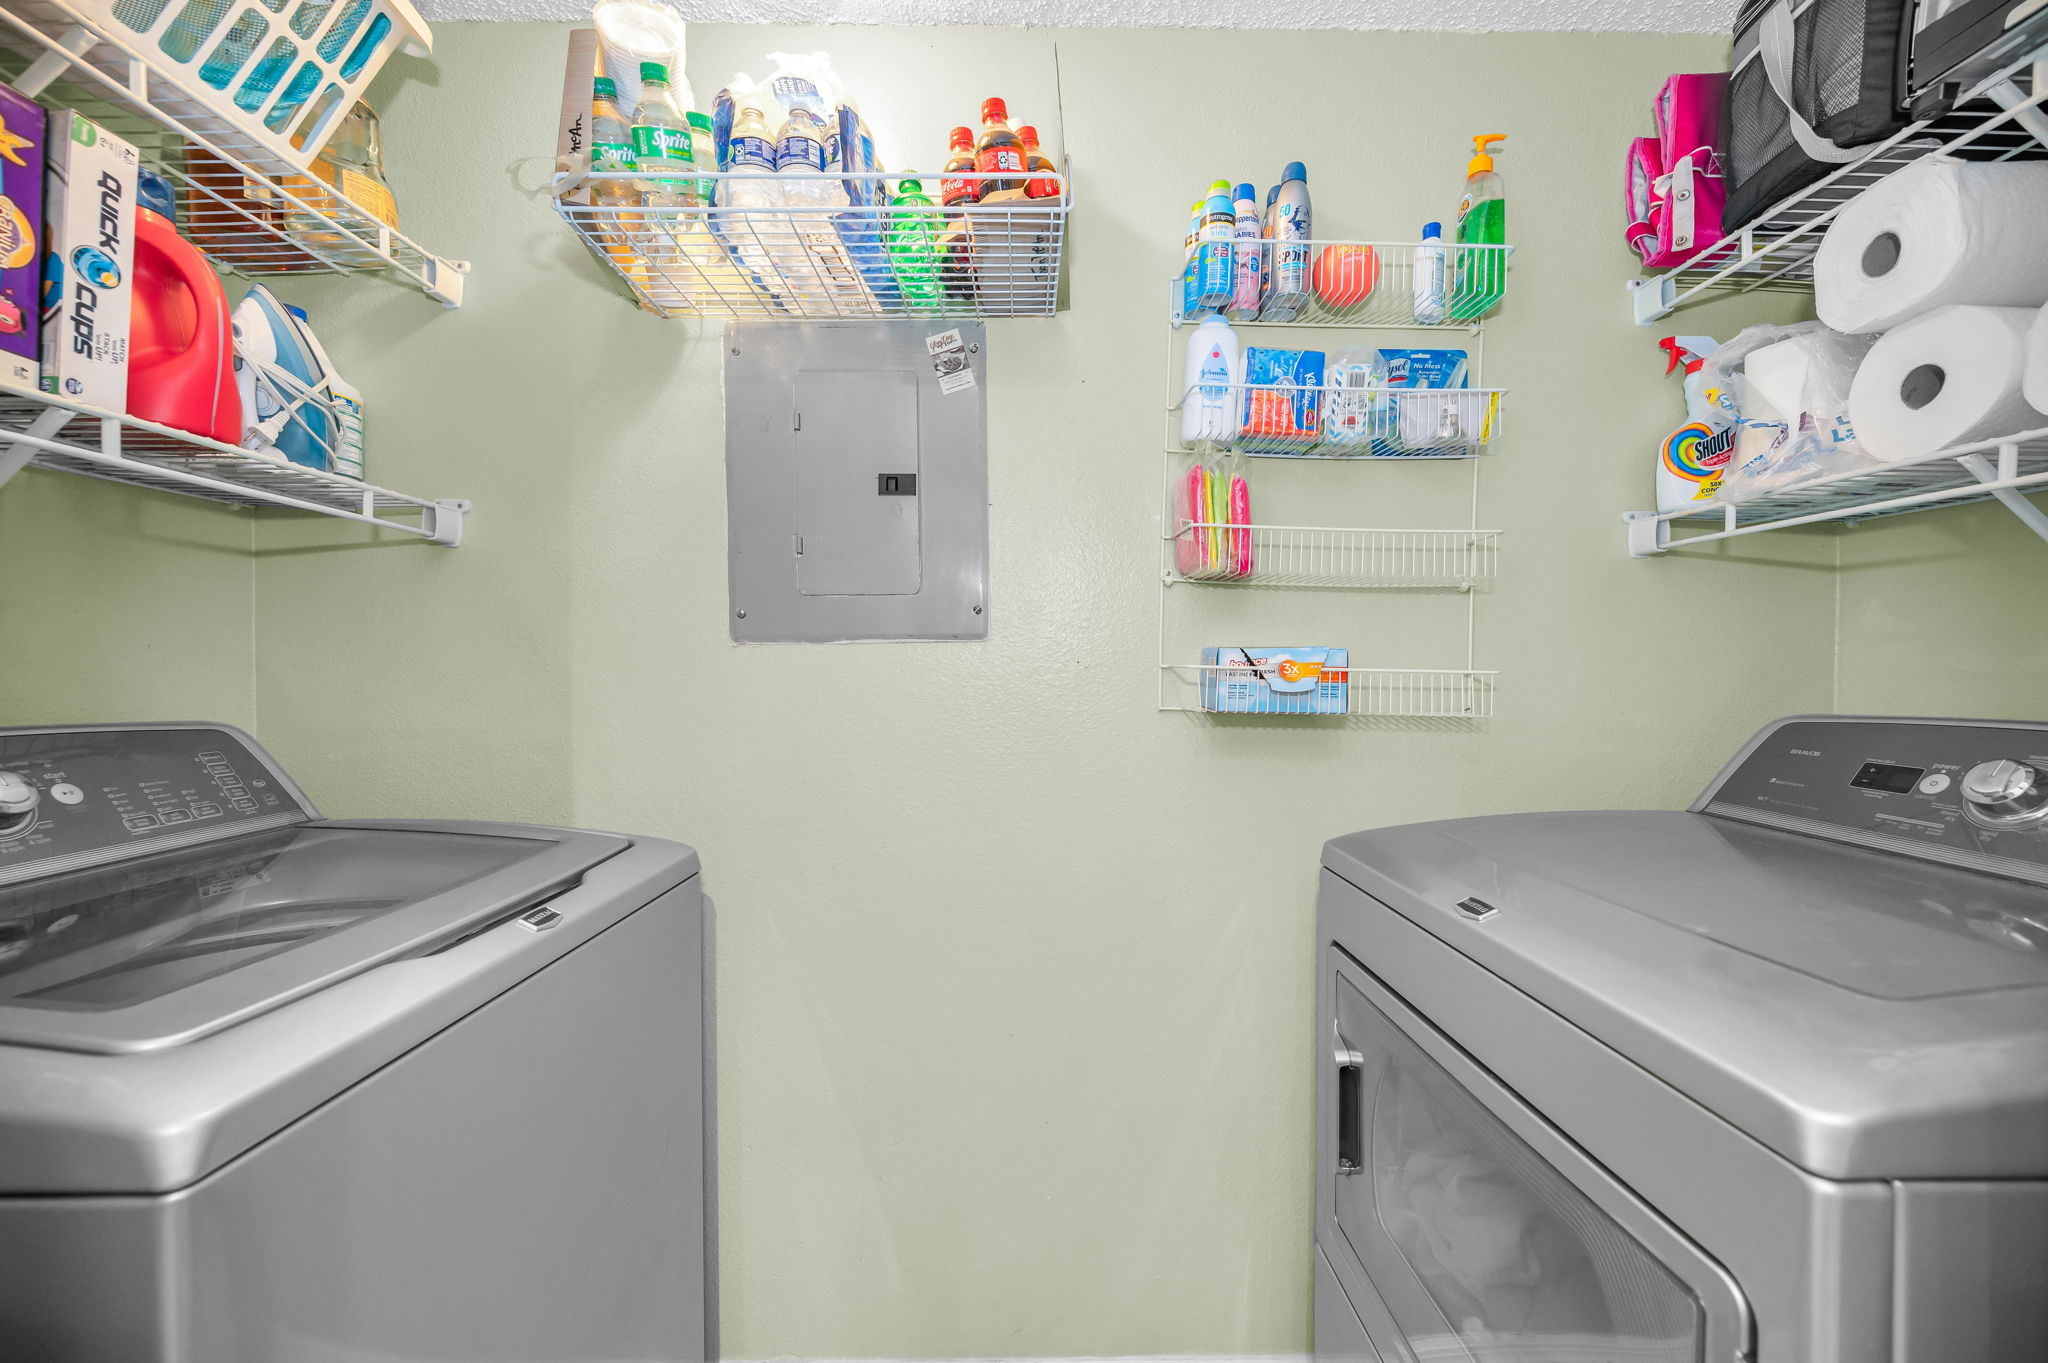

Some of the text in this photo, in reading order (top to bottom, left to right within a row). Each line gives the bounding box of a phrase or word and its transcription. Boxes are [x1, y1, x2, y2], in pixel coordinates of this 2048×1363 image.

[652, 130, 690, 151] Sprite
[1694, 426, 1732, 461] SHOUT
[1230, 657, 1267, 671] bouce
[1282, 663, 1300, 675] 3x
[1931, 762, 1962, 771] power
